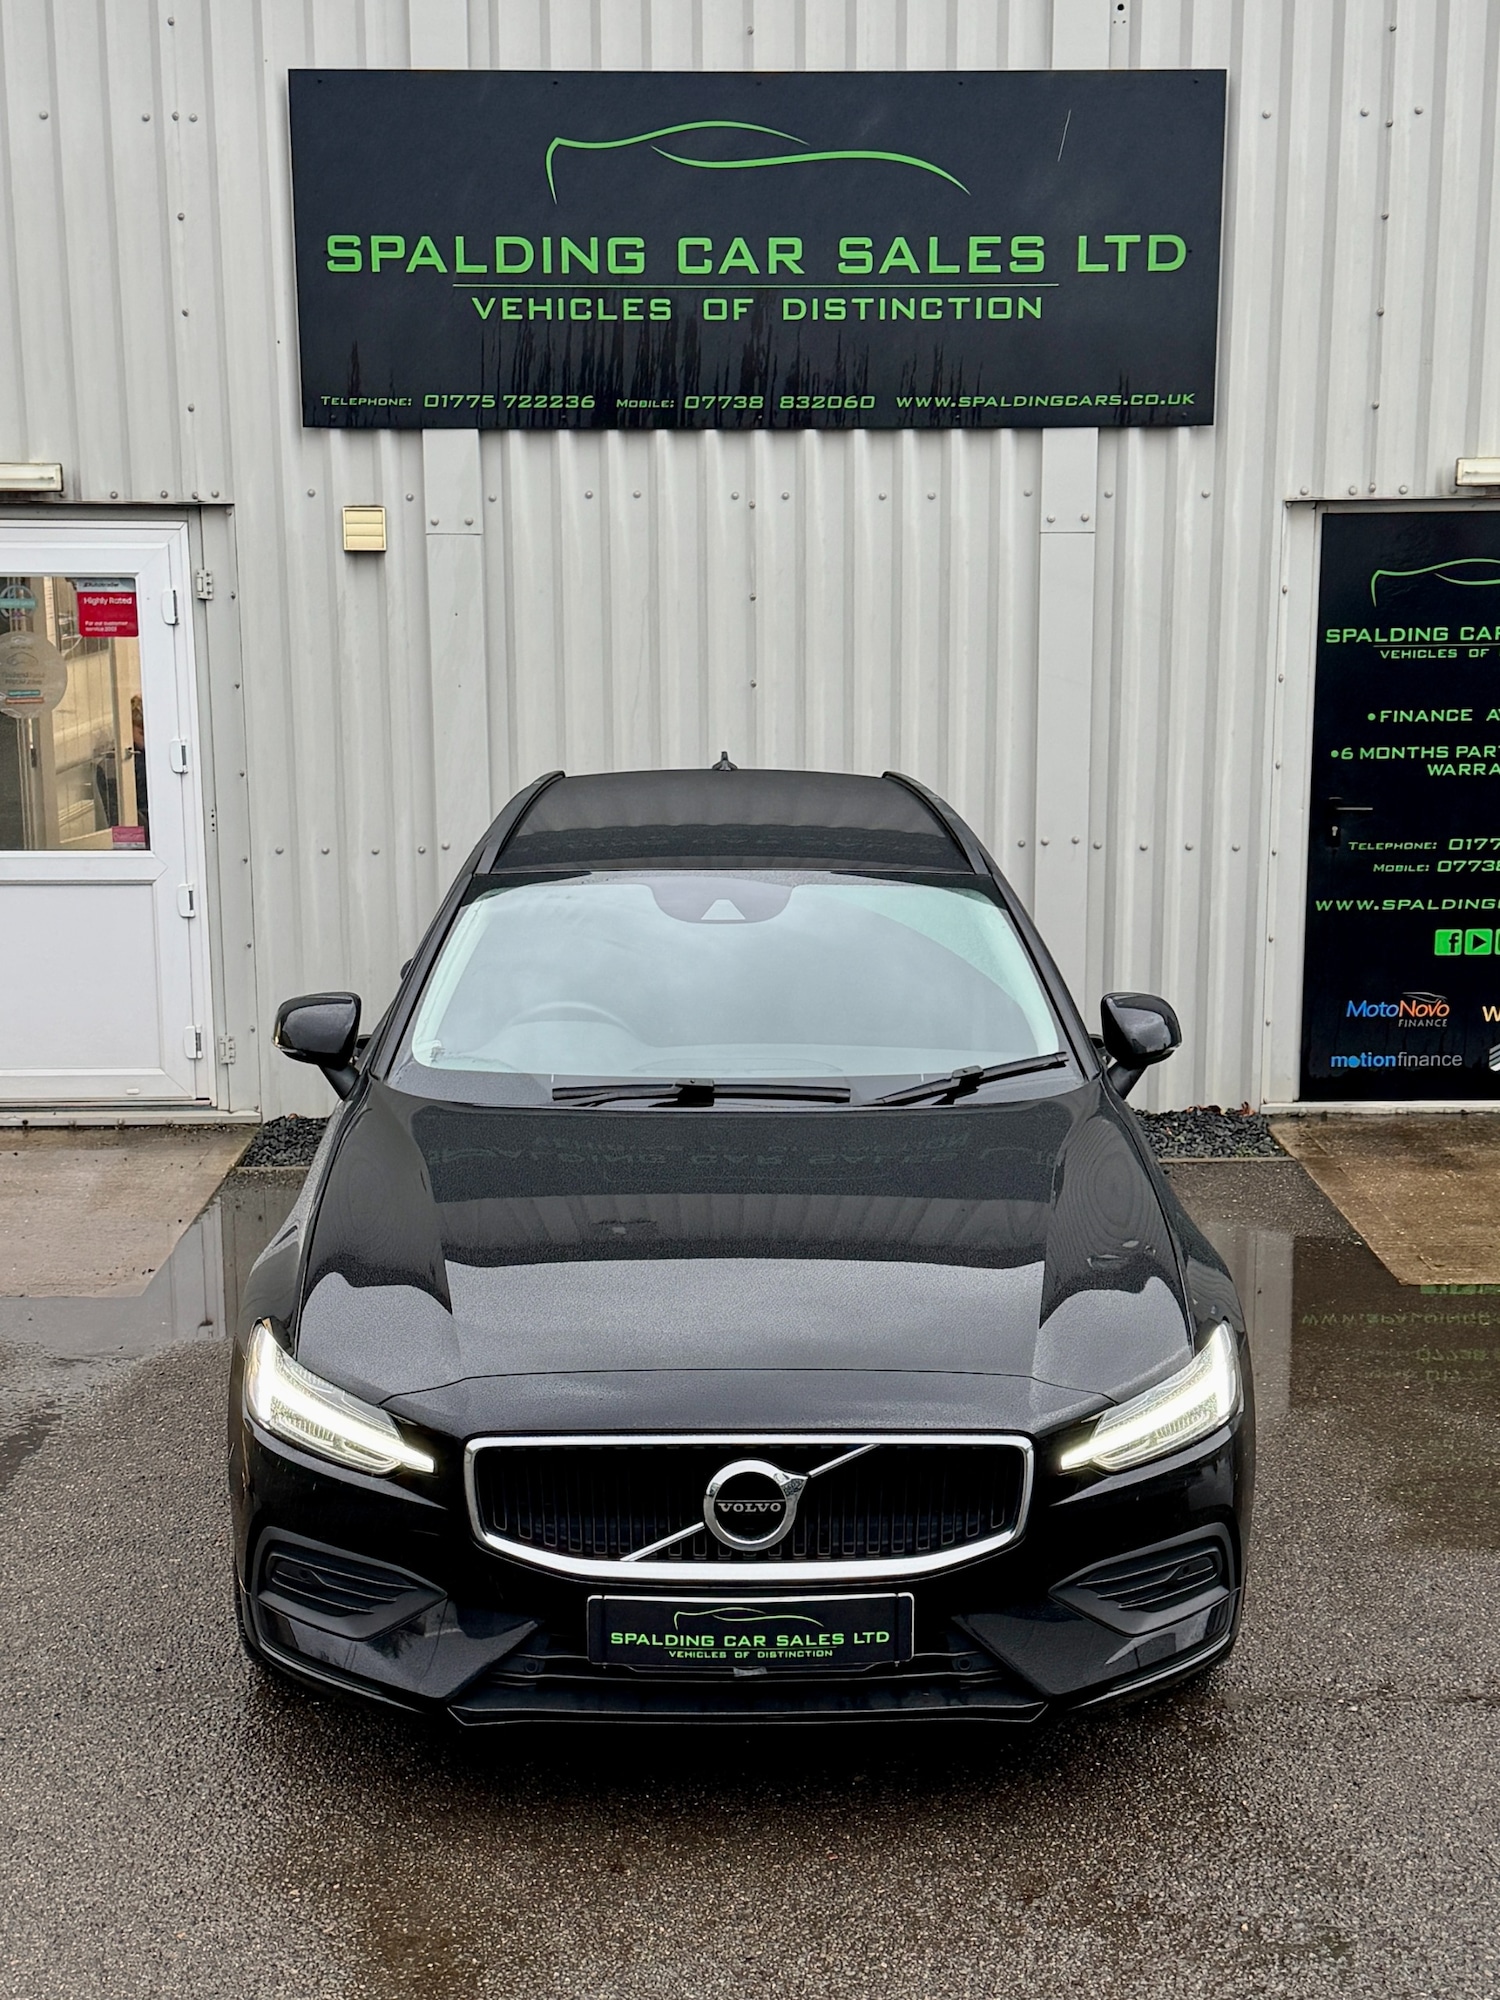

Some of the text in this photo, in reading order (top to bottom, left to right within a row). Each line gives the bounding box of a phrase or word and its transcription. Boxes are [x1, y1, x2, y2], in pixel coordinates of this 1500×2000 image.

[326, 234, 1188, 275] SPALDING CAR SALES LTD
[472, 296, 1043, 321] VEHICLES OF DISTINCTION
[424, 394, 496, 408] 01775
[502, 394, 595, 409] 722236
[684, 395, 764, 410] 07738
[779, 395, 876, 409] 832060
[896, 392, 1196, 408] WWW.SPALDINGCARS.CO.UK
[84, 597, 132, 606] Highly Rated
[1325, 627, 1449, 643] SPALDING
[1380, 648, 1490, 659] VEHICLES OF
[1380, 709, 1500, 722] FINANCE A
[1341, 745, 1500, 760] 6 MONTHS PAR
[1448, 838, 1500, 850] 0177
[1315, 898, 1500, 911] WWW.SPALDING
[1346, 998, 1450, 1018] MotoNovo
[1398, 1018, 1448, 1028] FINANCE
[717, 1502, 782, 1513] VOLVO
[610, 1631, 890, 1647] SPALDING CAR SALES LTD
[669, 1649, 833, 1659] VEHICLES OF DISTINCTION
